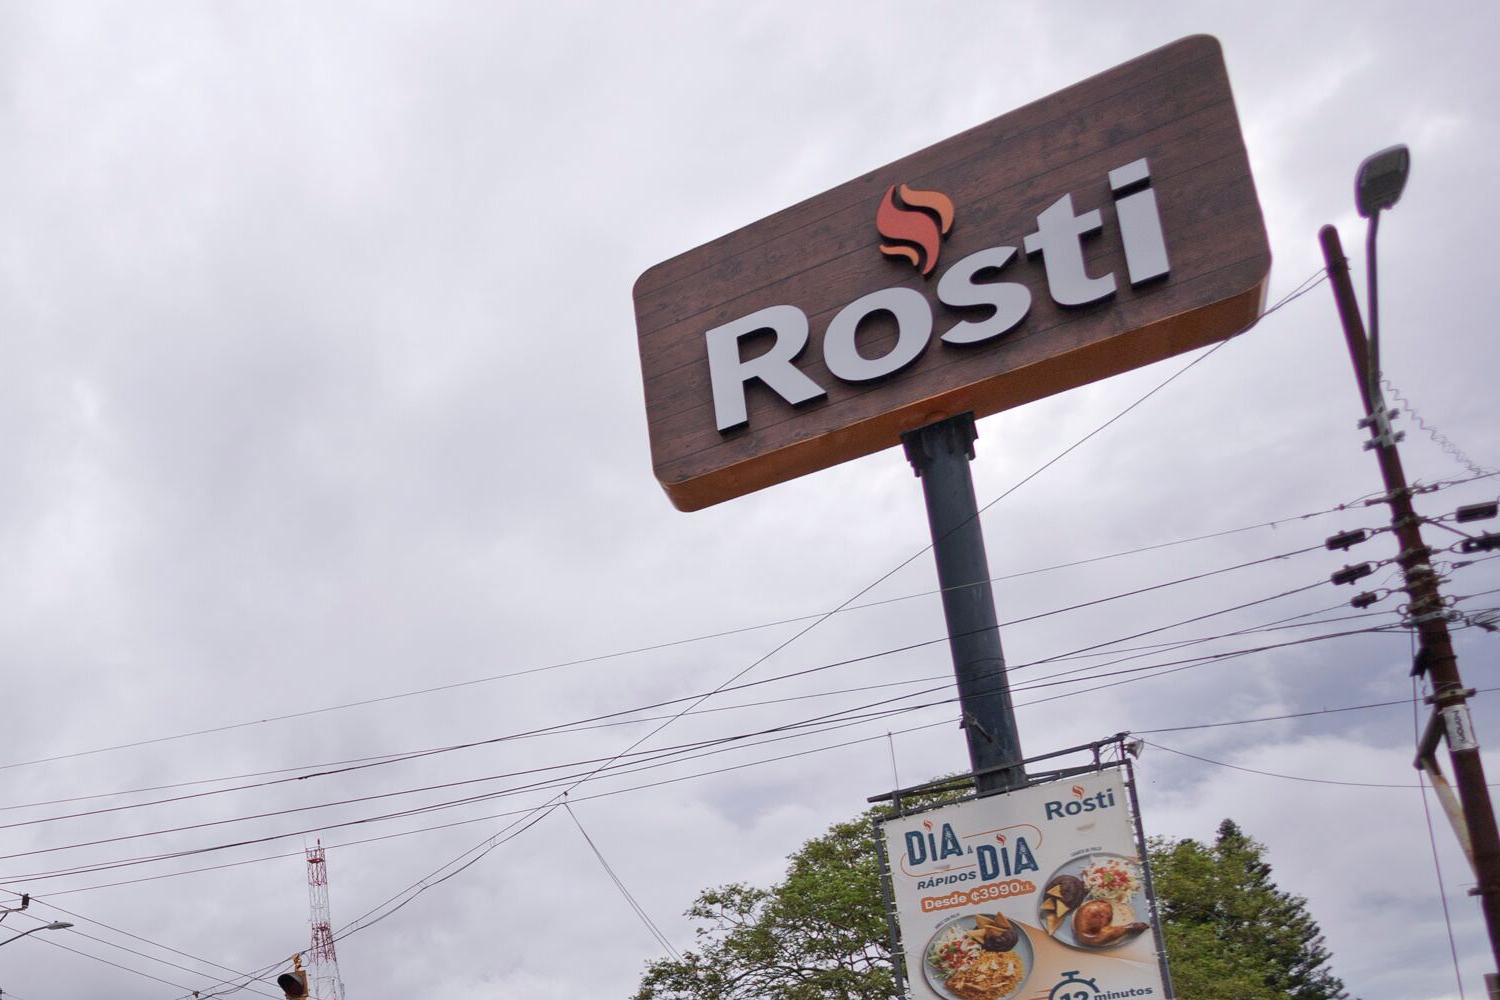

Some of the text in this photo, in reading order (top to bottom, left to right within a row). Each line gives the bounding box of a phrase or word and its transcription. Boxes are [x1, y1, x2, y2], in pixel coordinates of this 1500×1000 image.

[705, 157, 1170, 434] Rosti
[1044, 788, 1115, 820] Rosti
[917, 871, 977, 890] RÁPIDOS
[924, 894, 967, 910] Desde
